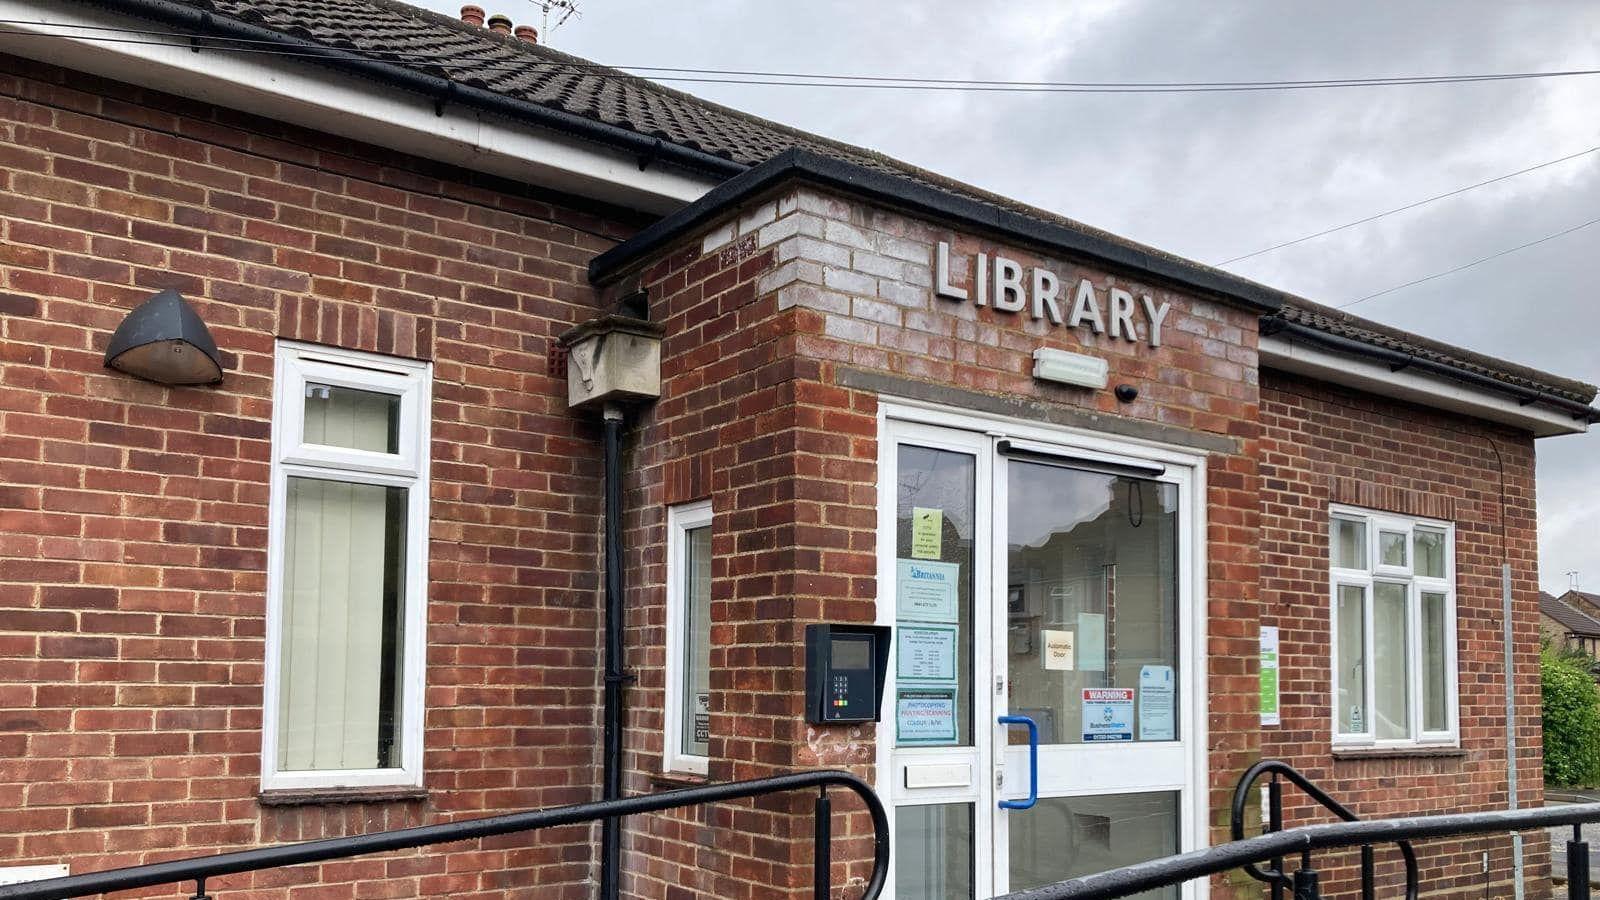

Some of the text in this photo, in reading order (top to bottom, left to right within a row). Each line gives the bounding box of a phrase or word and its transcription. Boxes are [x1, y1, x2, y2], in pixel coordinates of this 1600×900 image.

[936, 241, 1171, 348] LIBRARY
[1047, 642, 1072, 651] Automatic
[1088, 690, 1128, 700] WARNING
[696, 729, 710, 738] CCT
